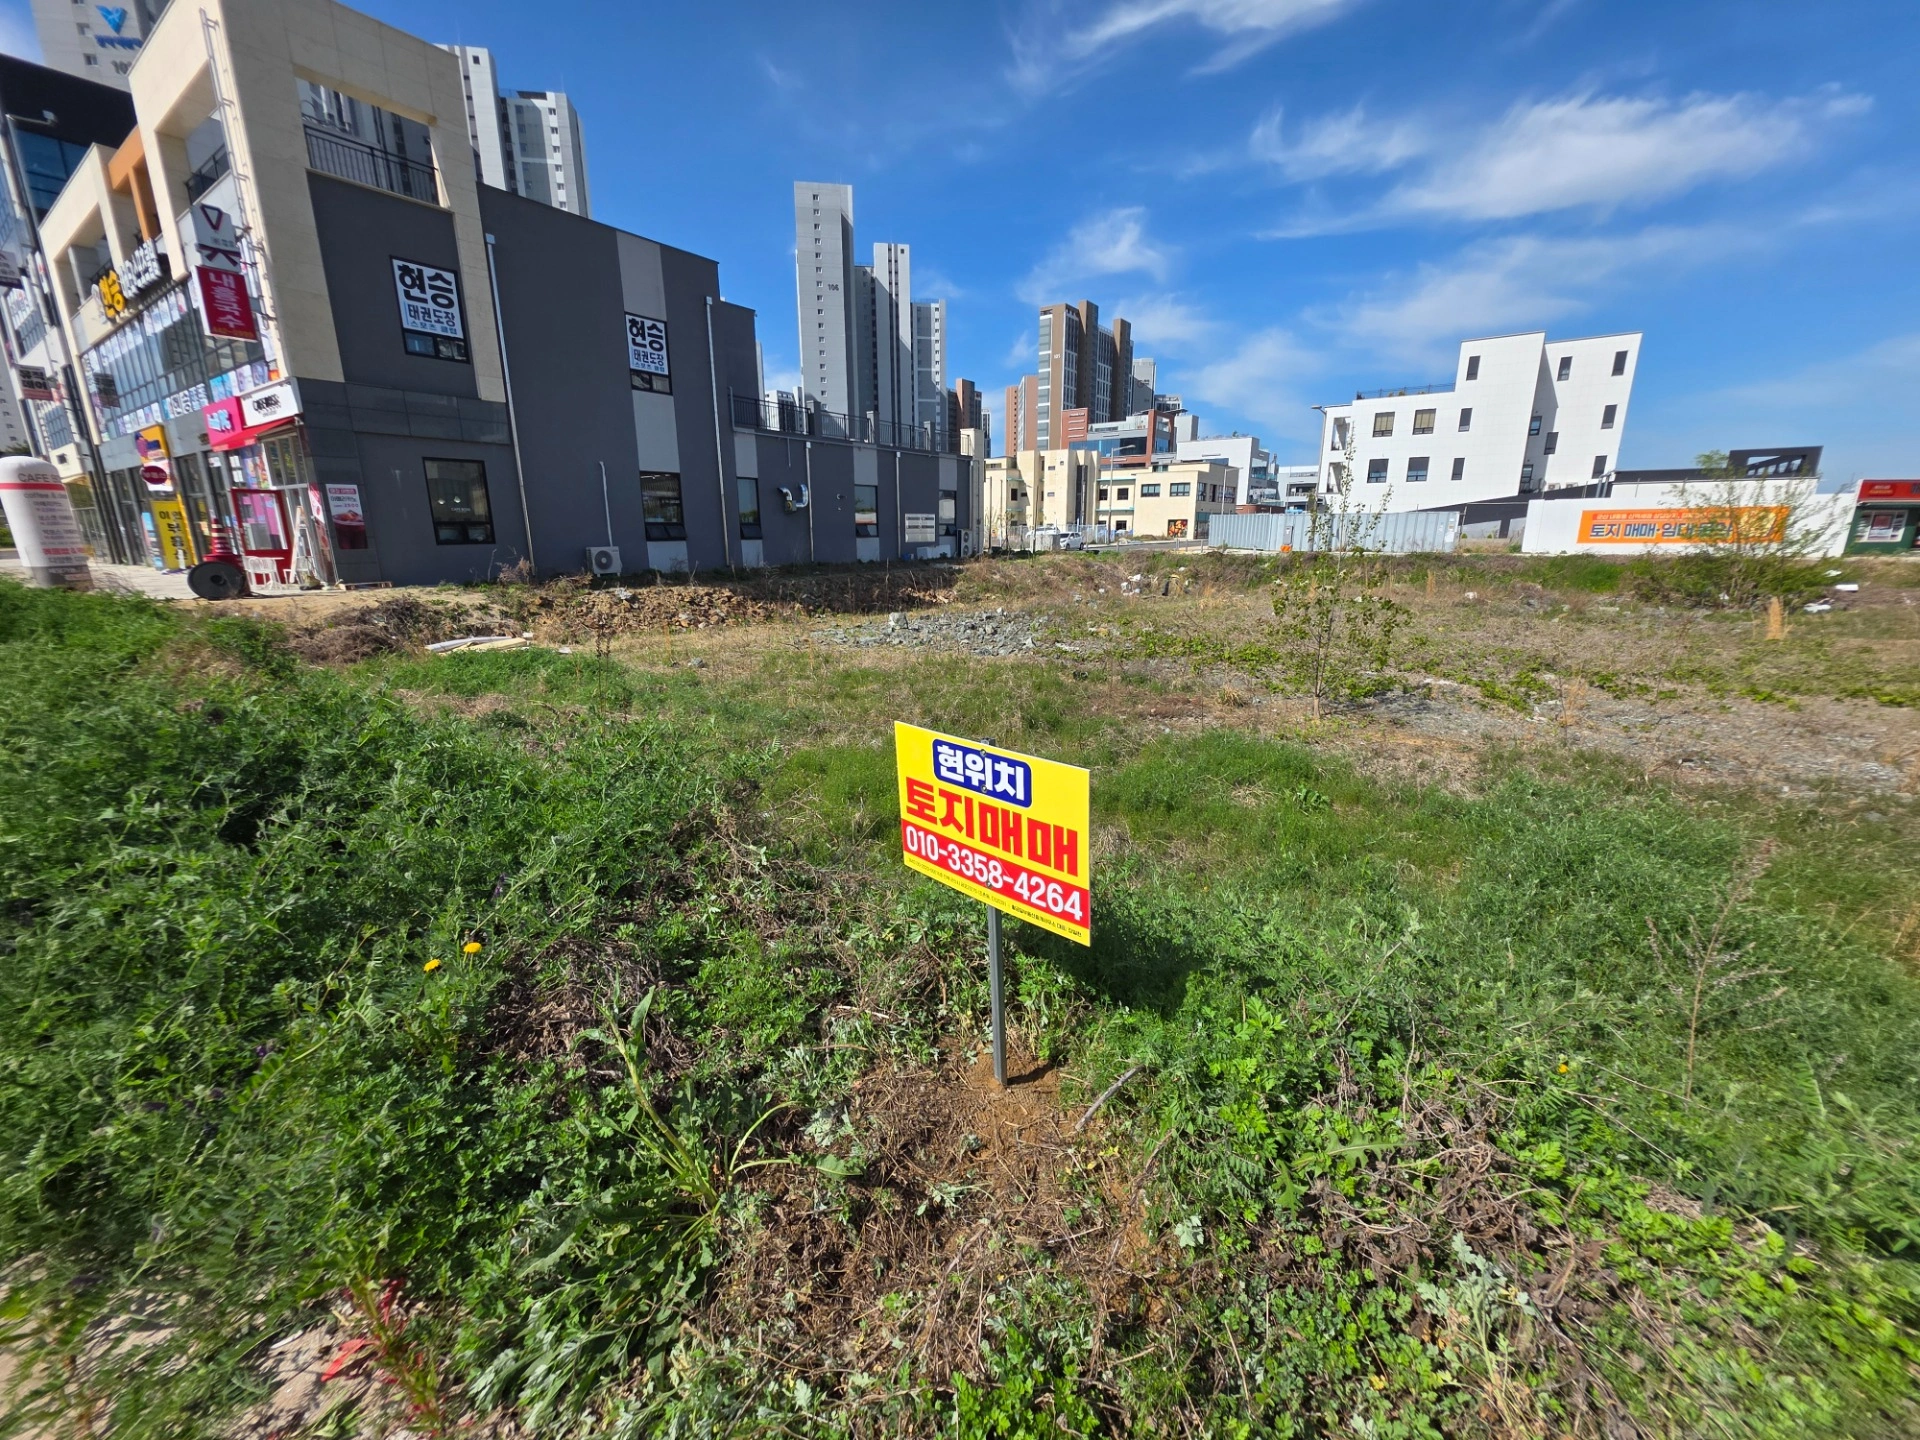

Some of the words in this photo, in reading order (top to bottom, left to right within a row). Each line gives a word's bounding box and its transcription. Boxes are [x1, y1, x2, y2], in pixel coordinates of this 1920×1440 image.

[397, 264, 455, 310] 현승
[407, 303, 456, 327] 태권도장
[410, 320, 437, 331] 스포츠
[628, 318, 664, 352] 현승
[633, 348, 665, 367] 태권도장
[18, 472, 50, 483] CAFE
[1590, 523, 1621, 537] 토지
[937, 745, 1025, 800] 현위치
[906, 776, 1078, 878] 토지매매
[905, 825, 1083, 921] 010-3358-4264
